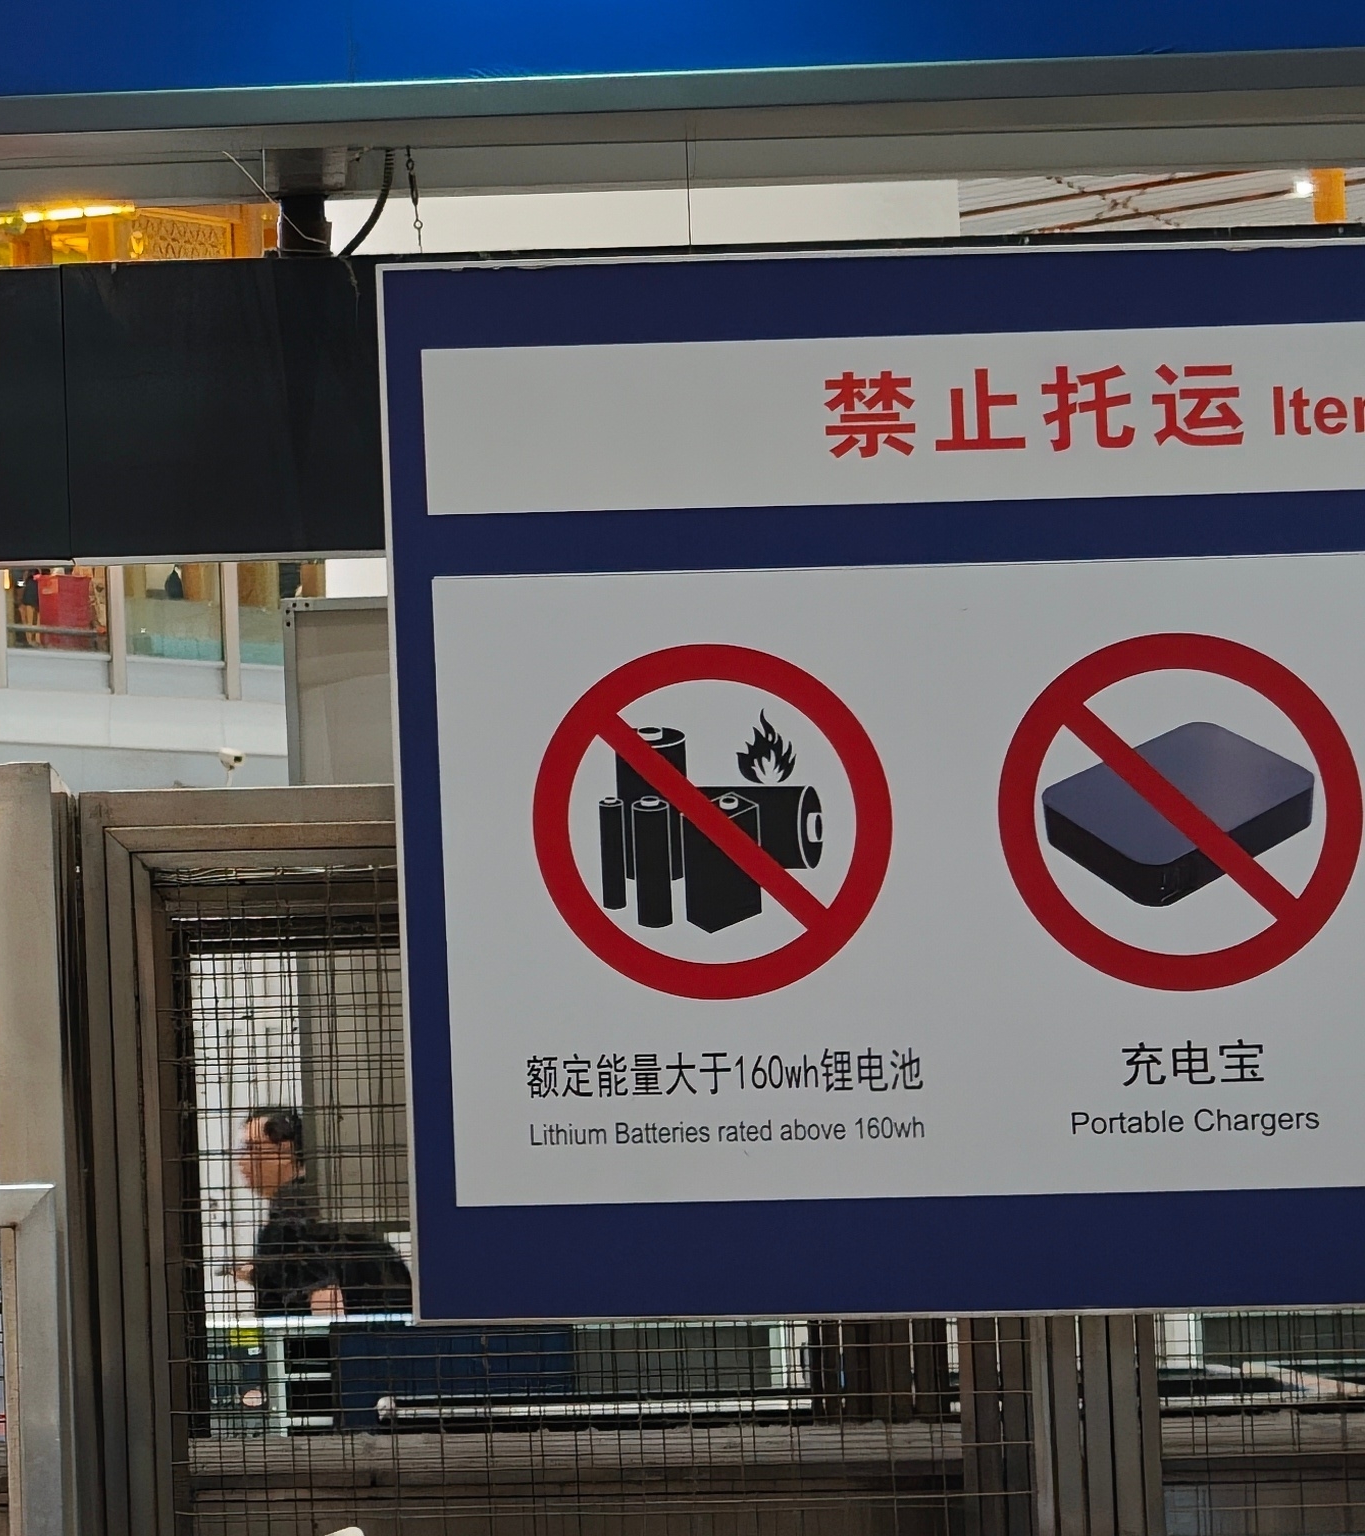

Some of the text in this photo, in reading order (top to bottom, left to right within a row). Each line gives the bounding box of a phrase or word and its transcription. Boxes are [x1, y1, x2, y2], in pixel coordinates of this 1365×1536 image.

[825, 365, 1243, 458] 禁止托运
[527, 1048, 923, 1098] 额定能量大于160wh锂电池
[1122, 1039, 1264, 1086] 充电宝
[531, 1116, 924, 1145] Lithium Batteries rated above 160wh
[1072, 1109, 1319, 1136] Portable Chargers
